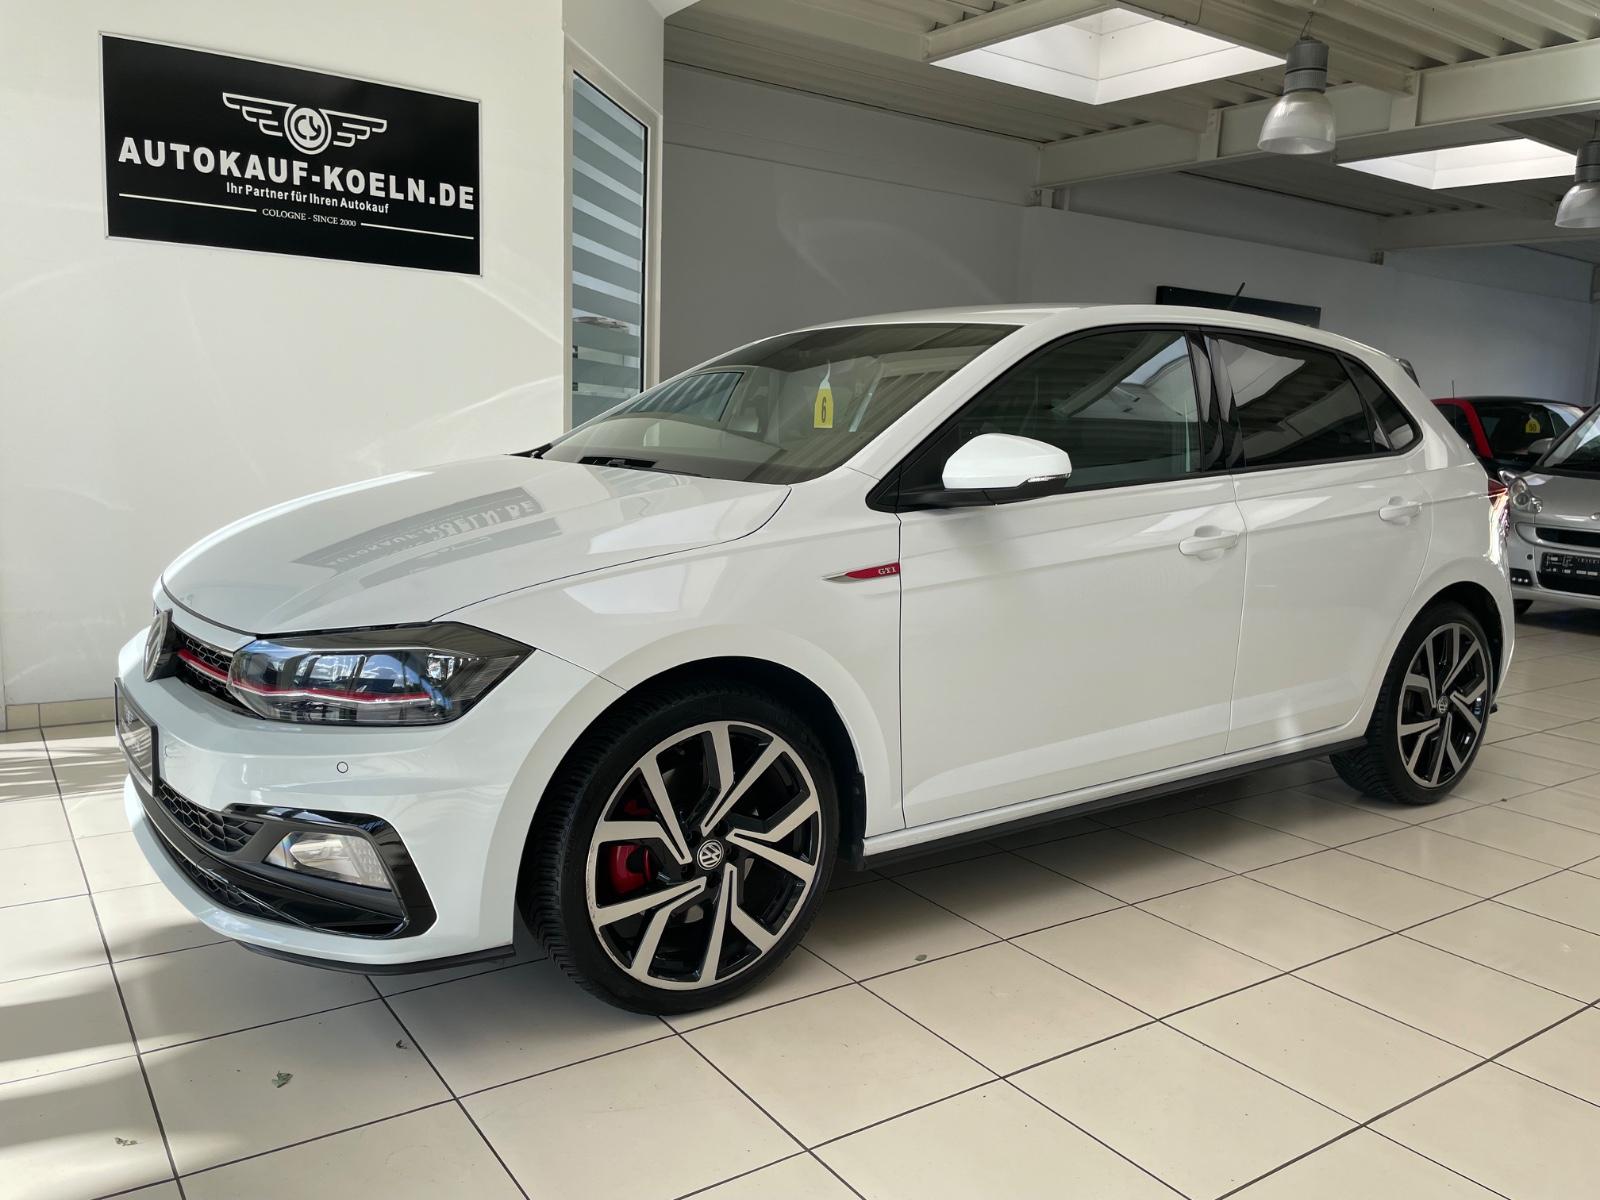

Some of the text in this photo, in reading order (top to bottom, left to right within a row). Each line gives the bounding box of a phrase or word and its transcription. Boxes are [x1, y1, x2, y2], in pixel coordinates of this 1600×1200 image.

[118, 136, 475, 210] AUTOKAUF-KOELN.DE
[226, 182, 389, 214] Ihr Partner für Ihren Autokauf
[262, 208, 307, 221] COLOGNE
[312, 214, 338, 225] SINCE
[339, 218, 357, 227] 2000
[821, 396, 827, 424] 6
[878, 566, 897, 575] GTI
